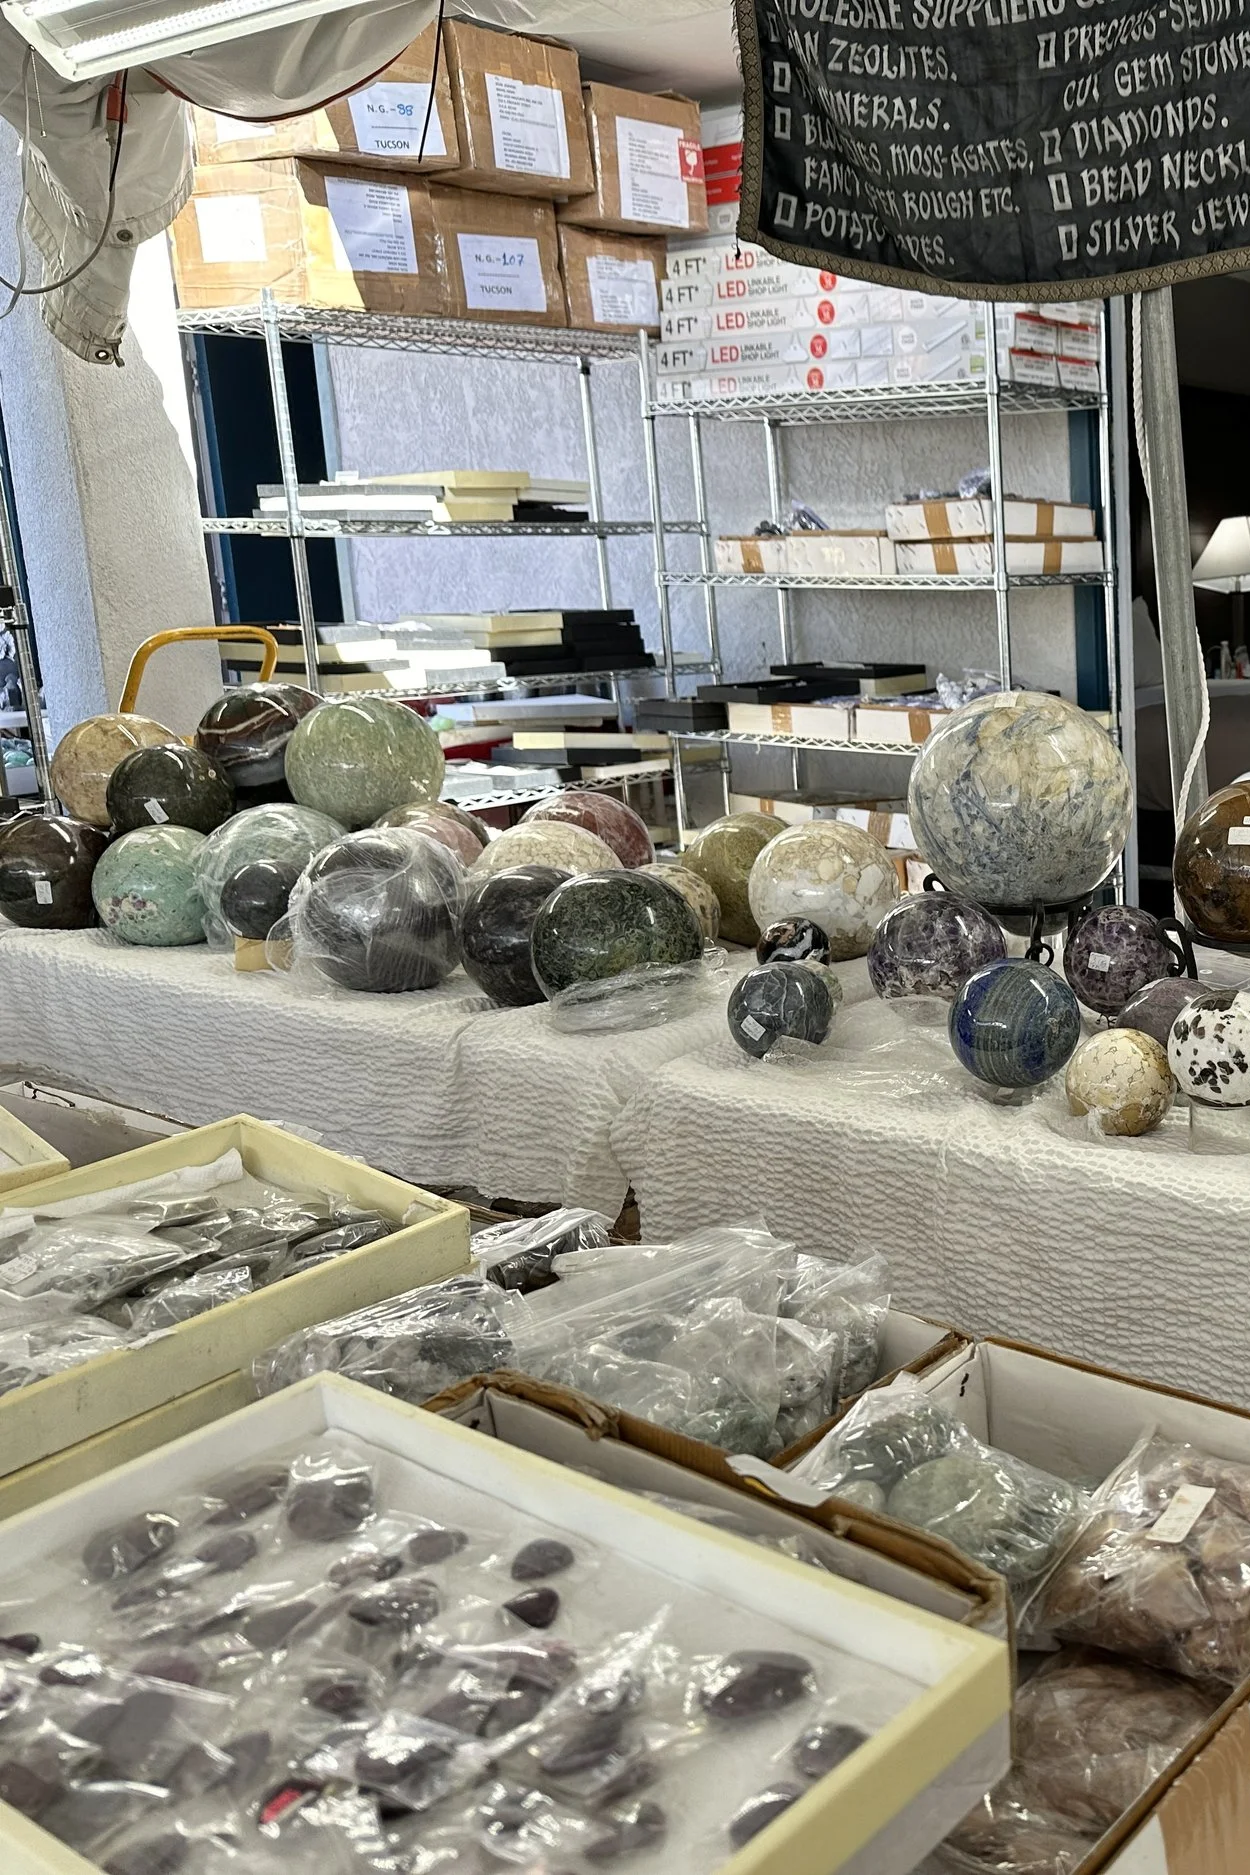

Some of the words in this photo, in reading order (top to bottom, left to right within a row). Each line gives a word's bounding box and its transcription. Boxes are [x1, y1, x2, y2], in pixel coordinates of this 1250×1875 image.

[828, 37, 957, 82] ZEOLITES.
[1114, 51, 1175, 98] GEM
[1070, 93, 1229, 159] DIAMONDS.
[374, 139, 410, 149] TUCSON
[889, 138, 1034, 179] MOSS-AGATES,
[1080, 157, 1152, 207] BEAD
[902, 188, 974, 223] ROUGH
[980, 186, 1021, 219] ETC.
[1086, 210, 1180, 257] SILVER
[673, 260, 680, 276] 4
[725, 251, 754, 270] LED
[480, 284, 513, 295] TUCSON
[717, 280, 746, 299] LED
[747, 275, 781, 286] LINKABLE
[666, 288, 673, 303] 4
[716, 312, 745, 330] LED
[746, 308, 779, 319] LINKABLE
[665, 319, 673, 335] 4
[711, 345, 739, 363] LED
[740, 343, 772, 353] LINKABLE
[661, 353, 668, 368] 4
